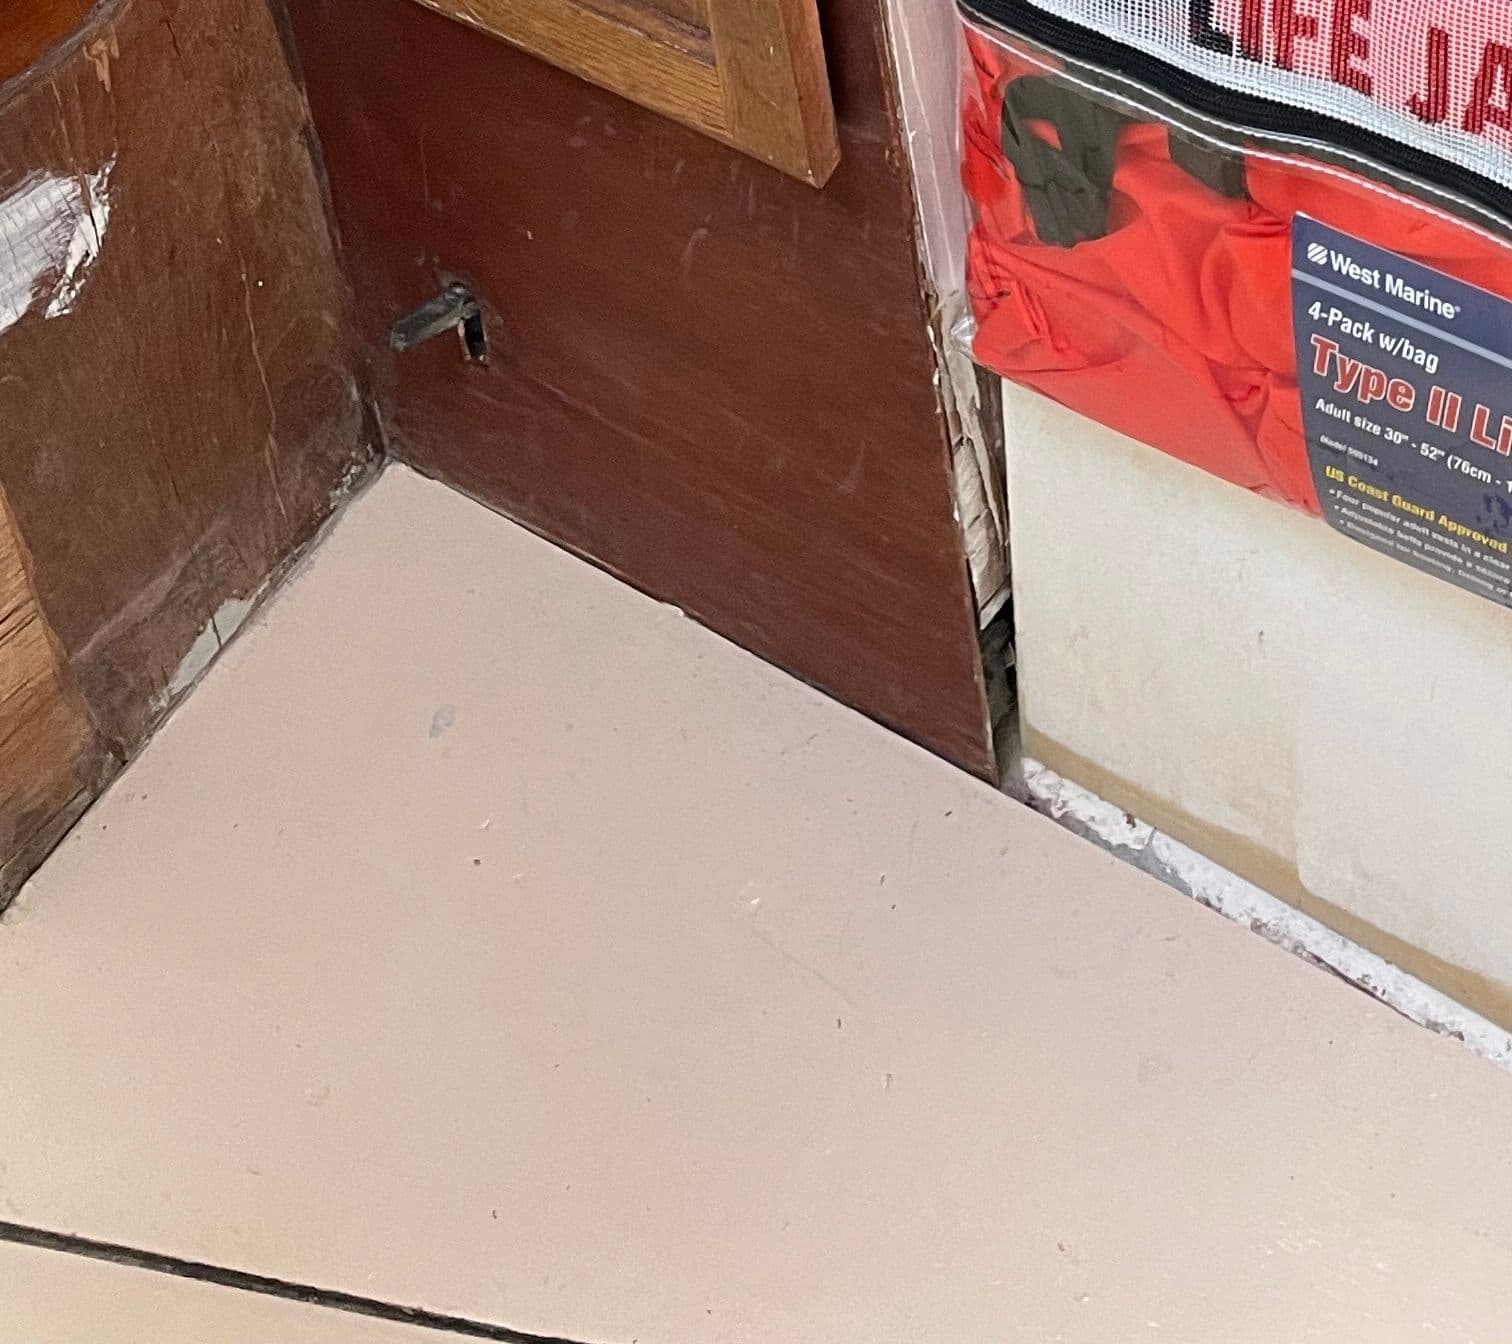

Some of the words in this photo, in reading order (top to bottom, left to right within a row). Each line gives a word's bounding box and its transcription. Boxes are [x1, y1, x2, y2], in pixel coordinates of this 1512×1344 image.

[1329, 250, 1380, 289] West
[1385, 274, 1457, 320] Marine
[1308, 301, 1375, 344] 4-Pack
[1378, 332, 1440, 375] w/bag
[1310, 332, 1416, 413] Type
[1426, 384, 1462, 433] II
[1315, 398, 1352, 424] Adult
[1354, 416, 1381, 435] size
[1384, 426, 1410, 445] 30"
[1420, 442, 1446, 461] 52"
[1447, 454, 1493, 484] (76cm
[1326, 464, 1345, 483] US
[1348, 475, 1389, 502] Coast
[1392, 494, 1435, 522] Guard
[1438, 514, 1508, 554] Approved
